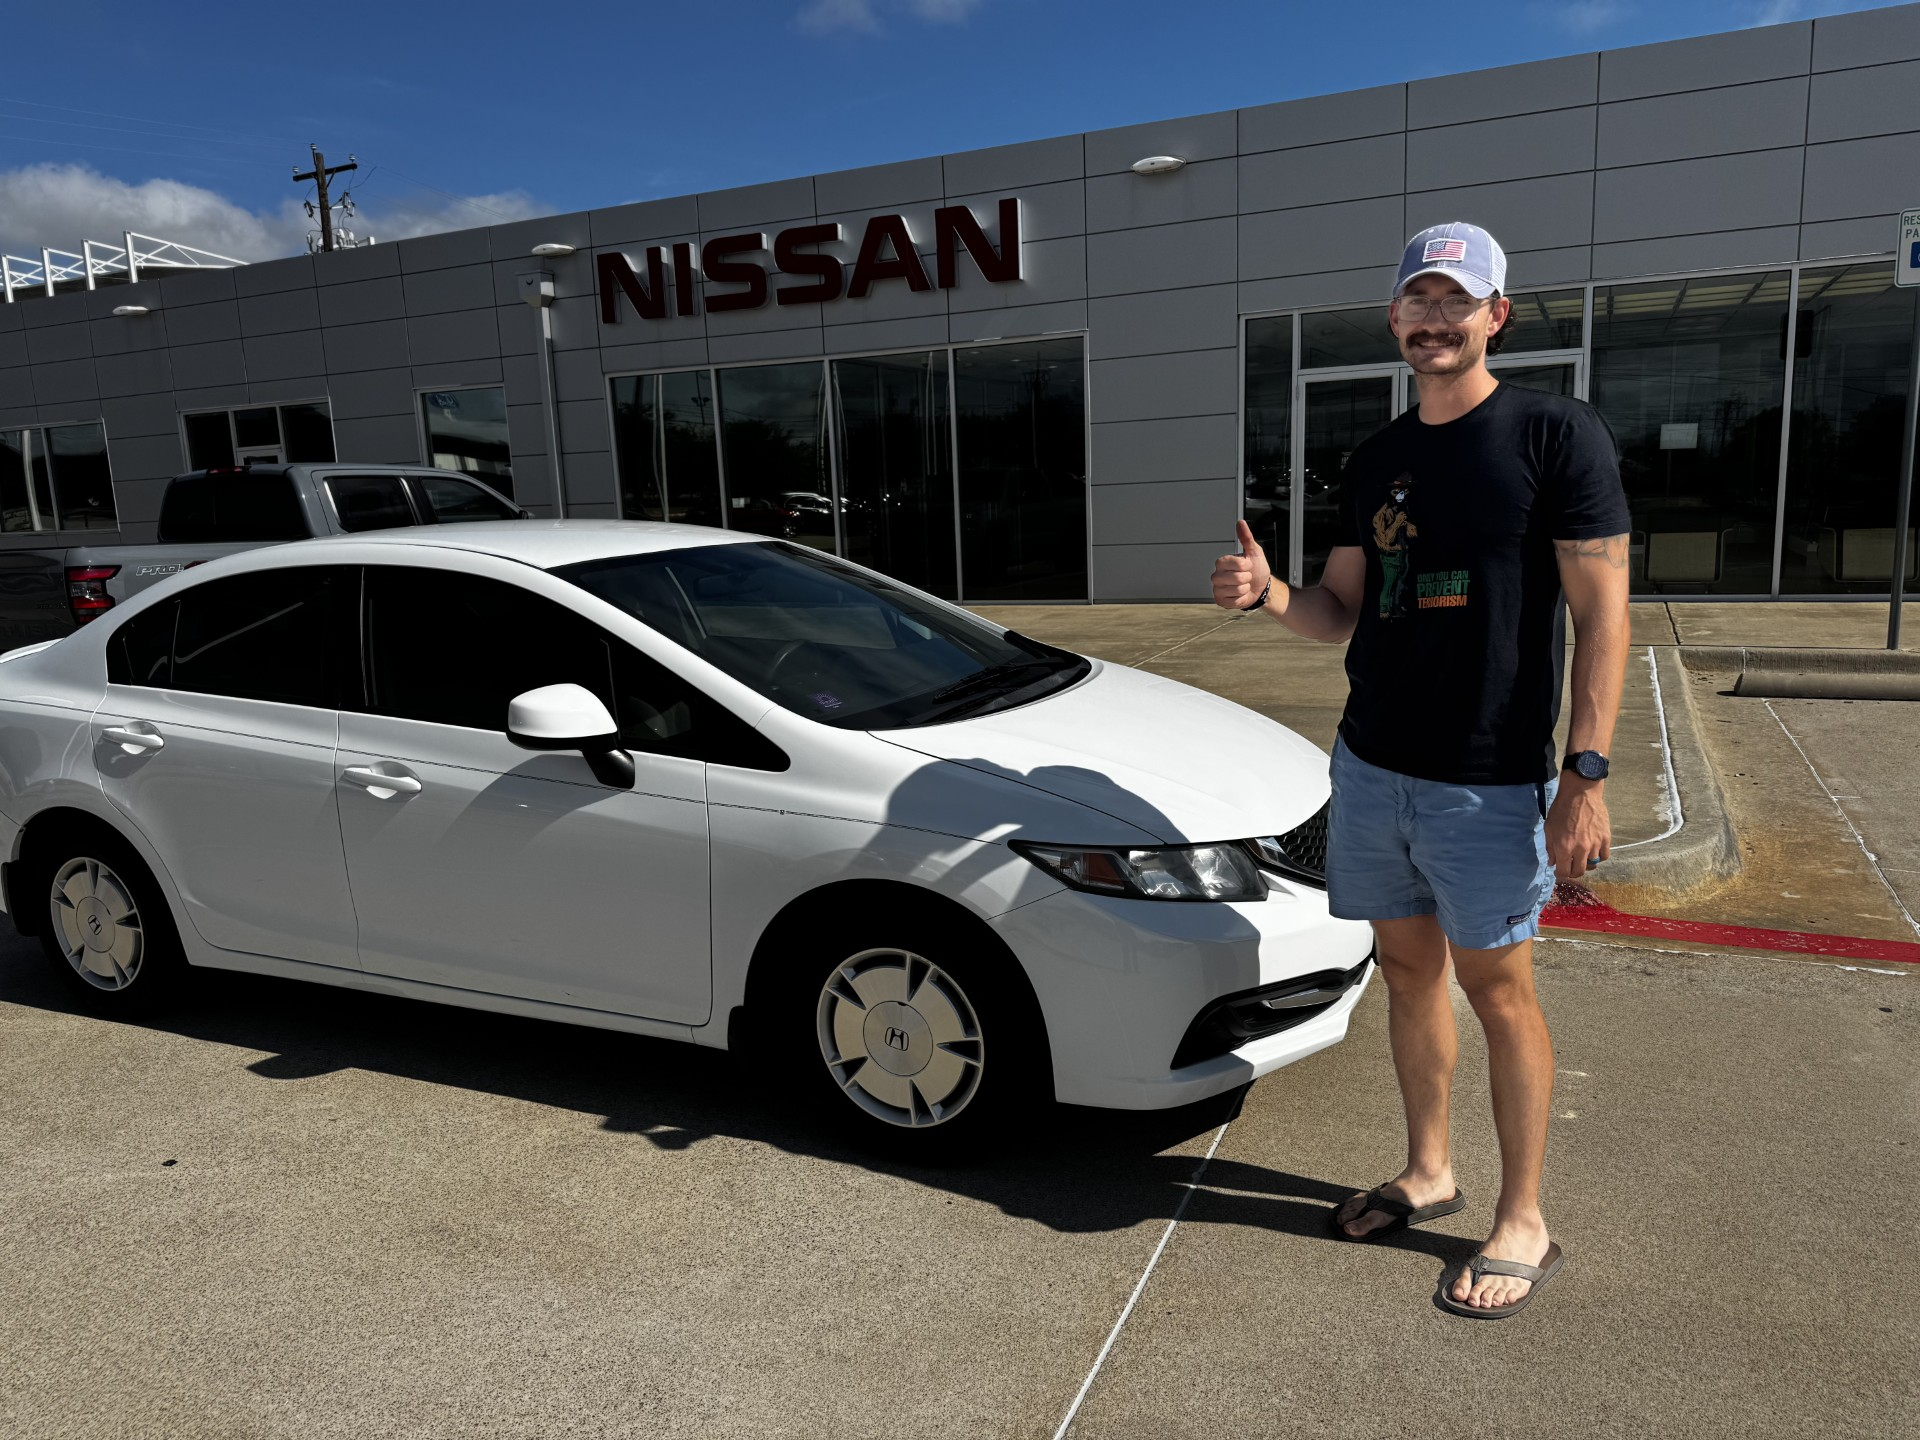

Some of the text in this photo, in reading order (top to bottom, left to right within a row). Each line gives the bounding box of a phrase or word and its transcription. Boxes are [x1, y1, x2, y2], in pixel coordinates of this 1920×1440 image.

[597, 197, 1023, 324] NISSAN
[1417, 569, 1469, 583] ONLY YOU CAN
[1416, 579, 1471, 597] PREVENT
[1417, 594, 1468, 609] TERRORISM
